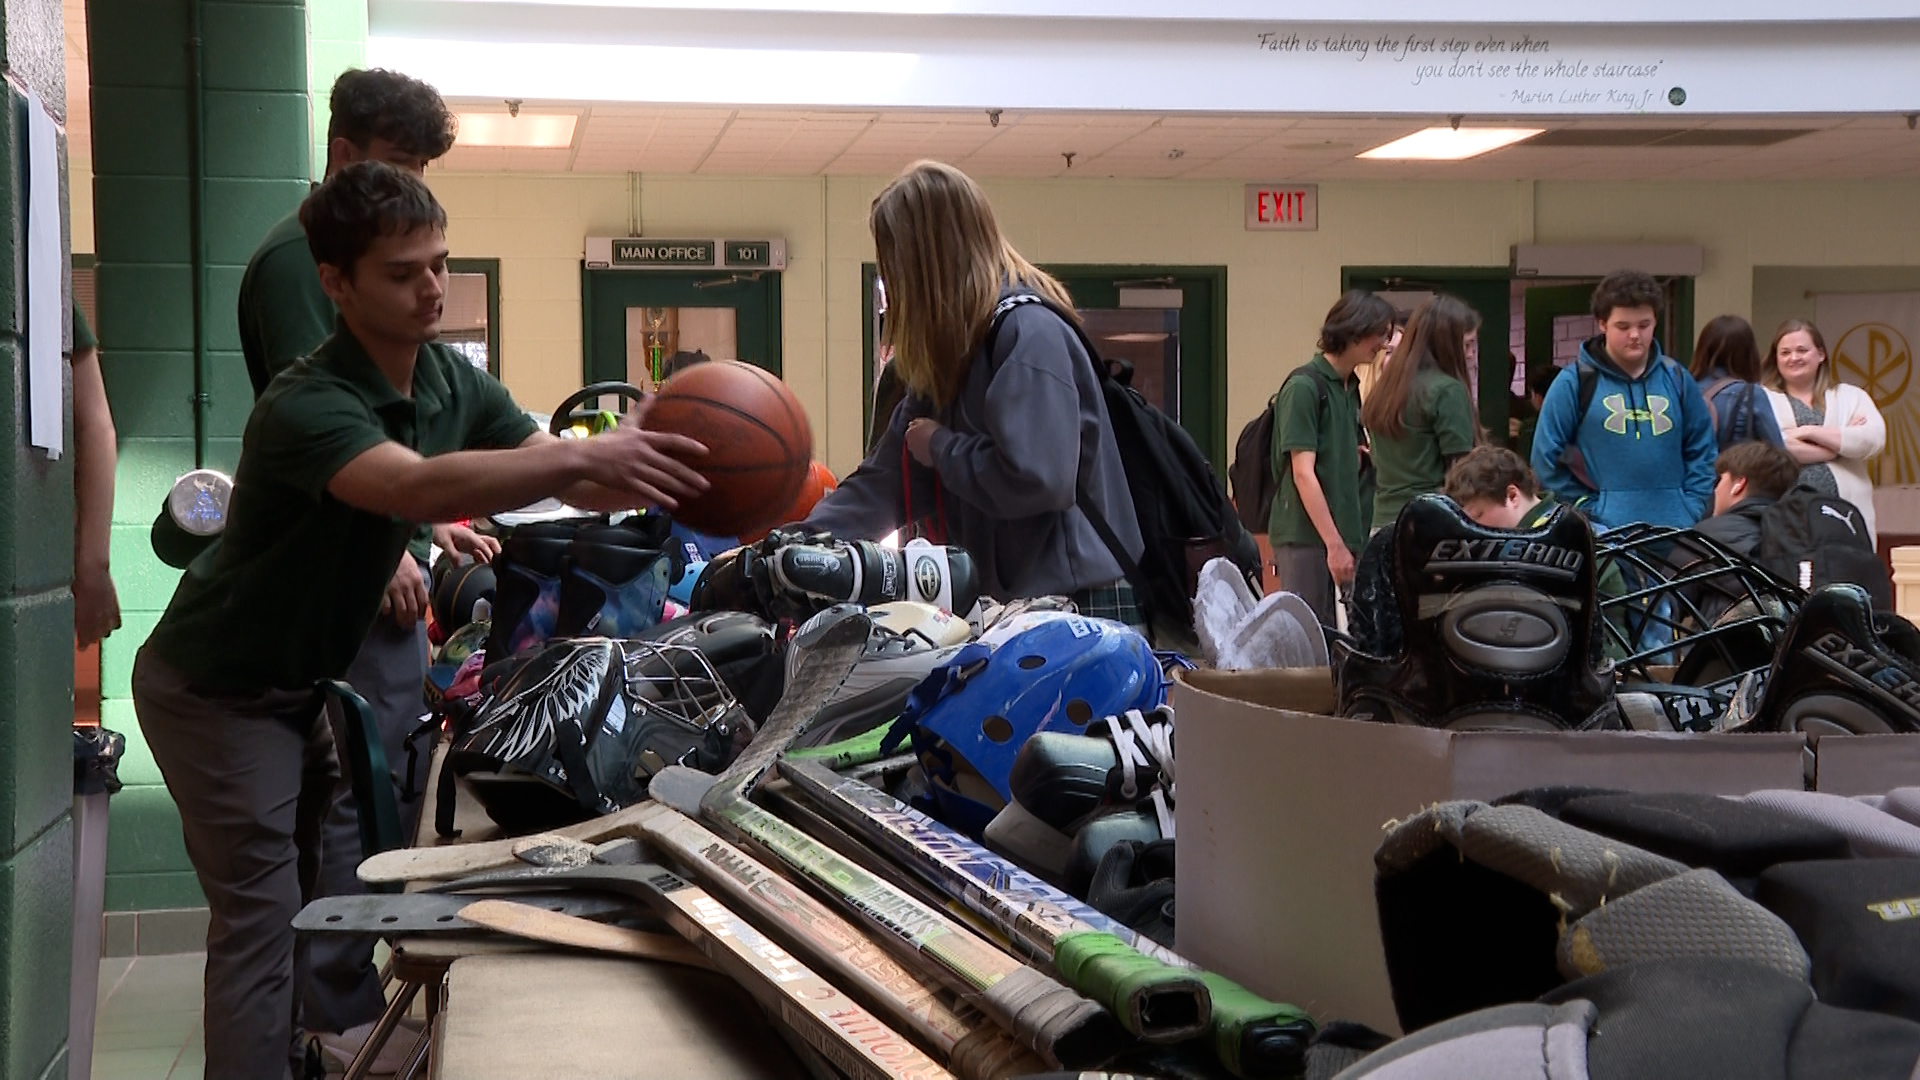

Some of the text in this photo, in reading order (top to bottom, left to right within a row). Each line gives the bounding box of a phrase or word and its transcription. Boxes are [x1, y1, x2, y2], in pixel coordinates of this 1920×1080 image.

[1306, 34, 1320, 52] is
[1323, 32, 1370, 62] taking
[1374, 33, 1400, 53] the
[1394, 33, 1436, 62] first
[1440, 37, 1470, 60] step
[1474, 34, 1506, 53] even
[1511, 33, 1550, 53] when
[1411, 64, 1444, 86] you
[1448, 58, 1484, 78] don't
[1488, 64, 1511, 78] see
[1515, 58, 1540, 78] the
[1543, 59, 1589, 78] whole
[1510, 89, 1554, 104] Martin
[1558, 88, 1602, 104] Luther
[1258, 191, 1306, 223] EXIT
[620, 247, 705, 260] MAIN OFFICE
[737, 247, 757, 259] 101
[1812, 632, 1920, 712] EXTER
